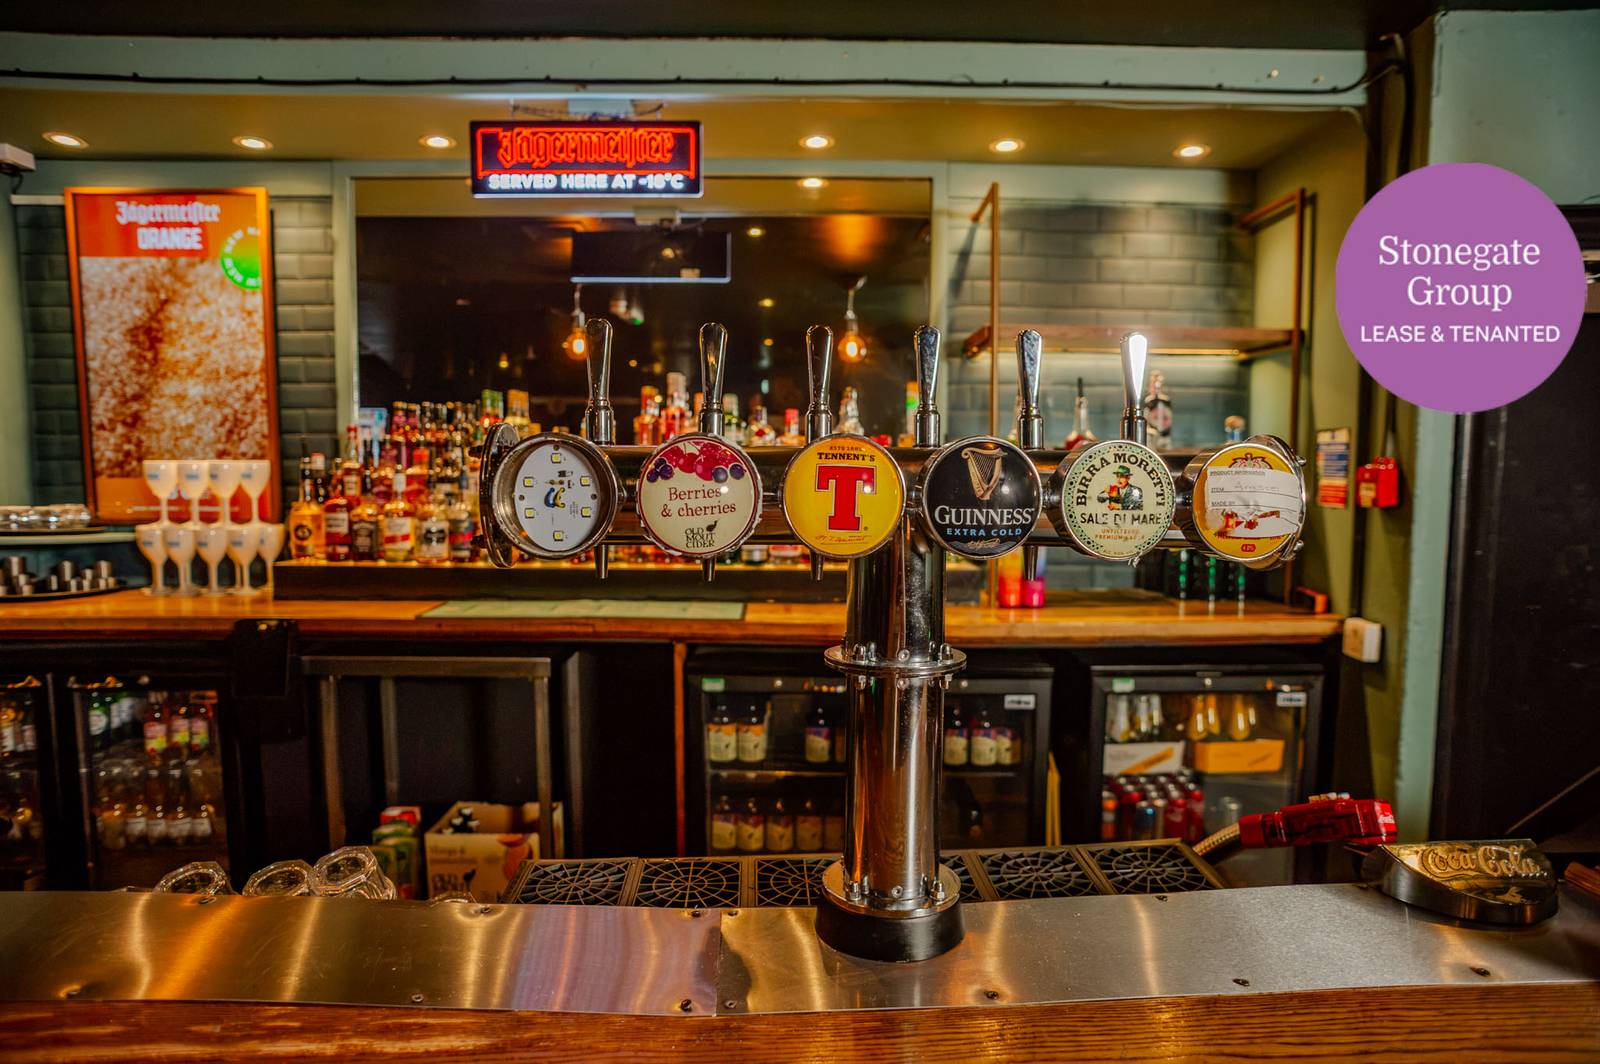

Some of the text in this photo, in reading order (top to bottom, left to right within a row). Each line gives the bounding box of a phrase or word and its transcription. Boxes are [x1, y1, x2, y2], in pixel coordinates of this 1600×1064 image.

[488, 173, 557, 189] SERVED
[561, 174, 608, 189] HERE
[611, 174, 636, 189] AT
[137, 227, 203, 250] ORANGE
[817, 452, 876, 462] TENNENT'S
[1076, 452, 1166, 506] BIRRA MORETTI
[668, 484, 722, 501] Berries
[815, 463, 877, 532] T
[661, 500, 737, 518] & cherries
[934, 504, 1032, 526] GUINNESS
[1080, 512, 1109, 525] SALE
[1131, 513, 1162, 525] MARE
[685, 527, 704, 535] OLD
[686, 532, 716, 542] MOUT
[946, 527, 1022, 536] EXTRA COLD
[685, 540, 715, 549] CIDER
